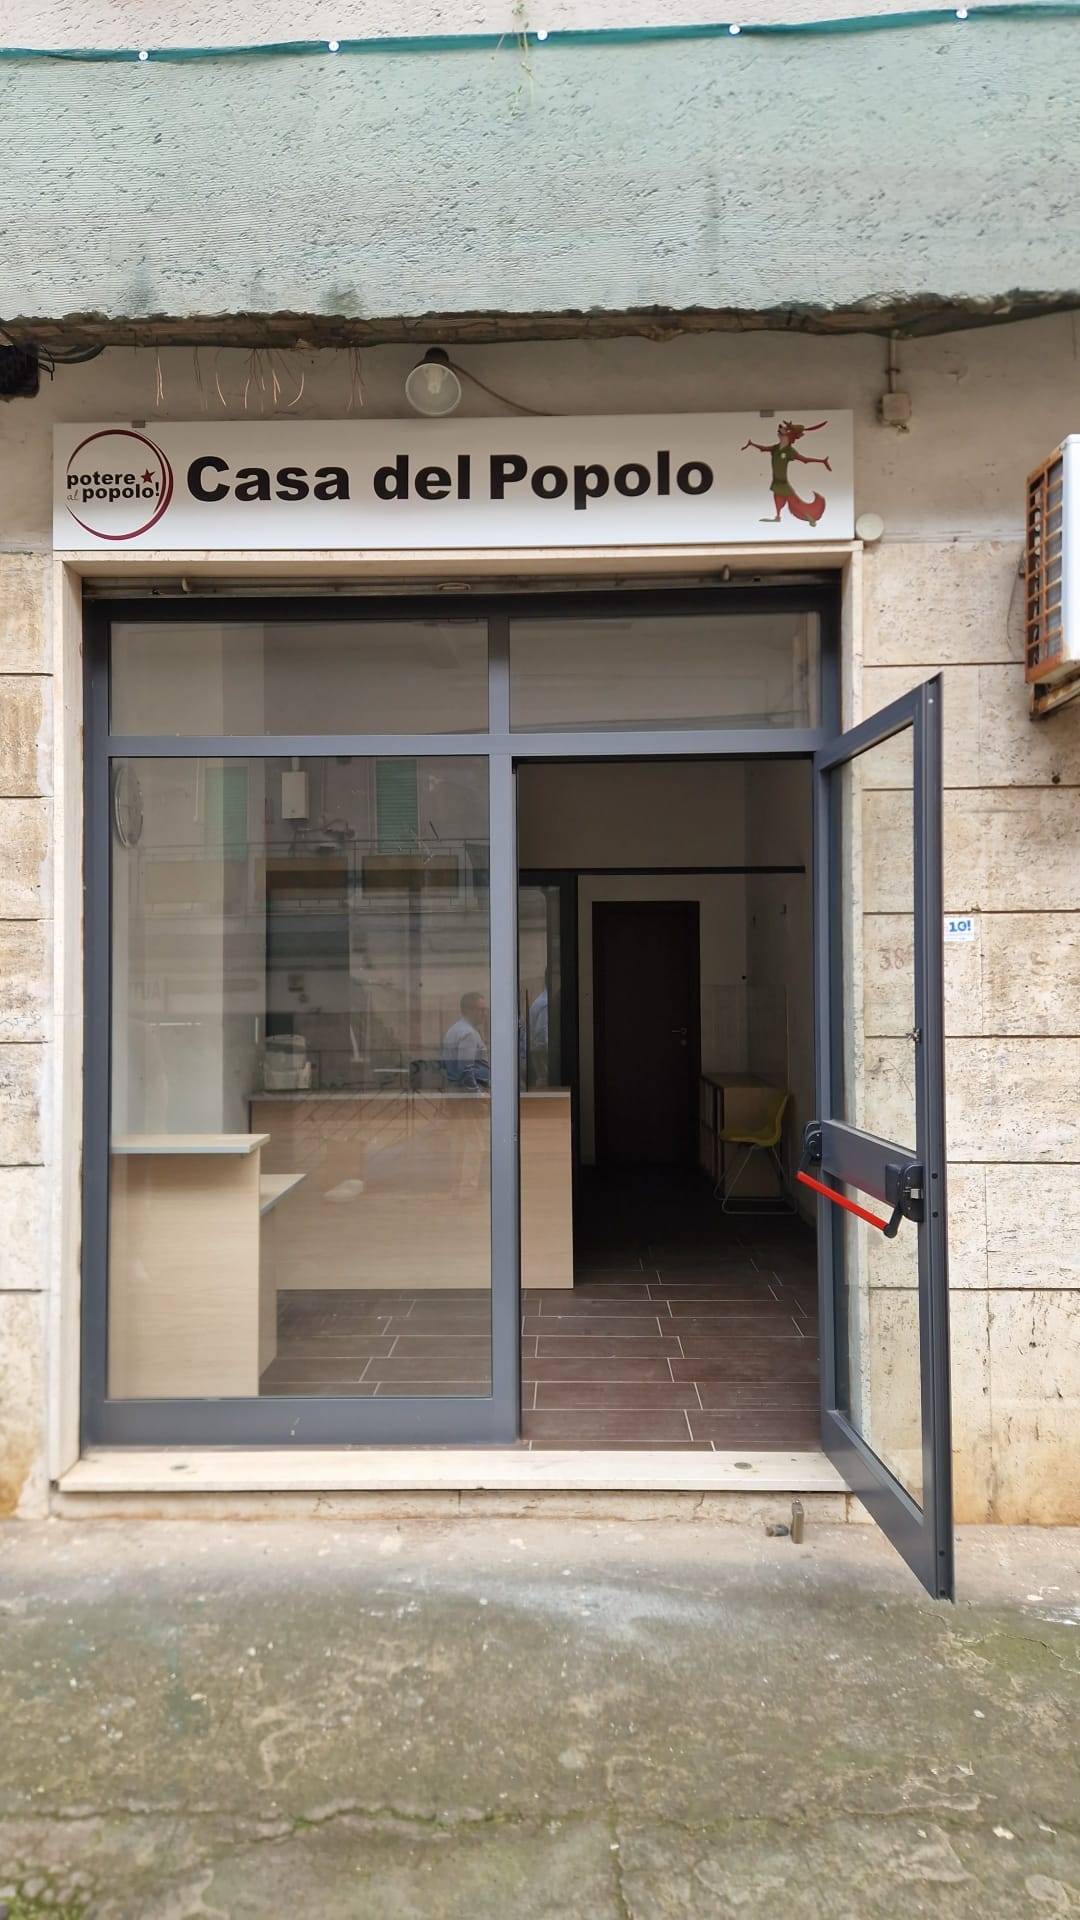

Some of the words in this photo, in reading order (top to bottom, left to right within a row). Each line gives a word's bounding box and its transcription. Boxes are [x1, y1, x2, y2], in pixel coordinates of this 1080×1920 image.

[67, 471, 136, 489] potere
[187, 455, 351, 502] Casa
[373, 454, 471, 500] del
[489, 450, 714, 511] Popolo
[67, 489, 80, 500] al
[82, 482, 159, 502] popolo!
